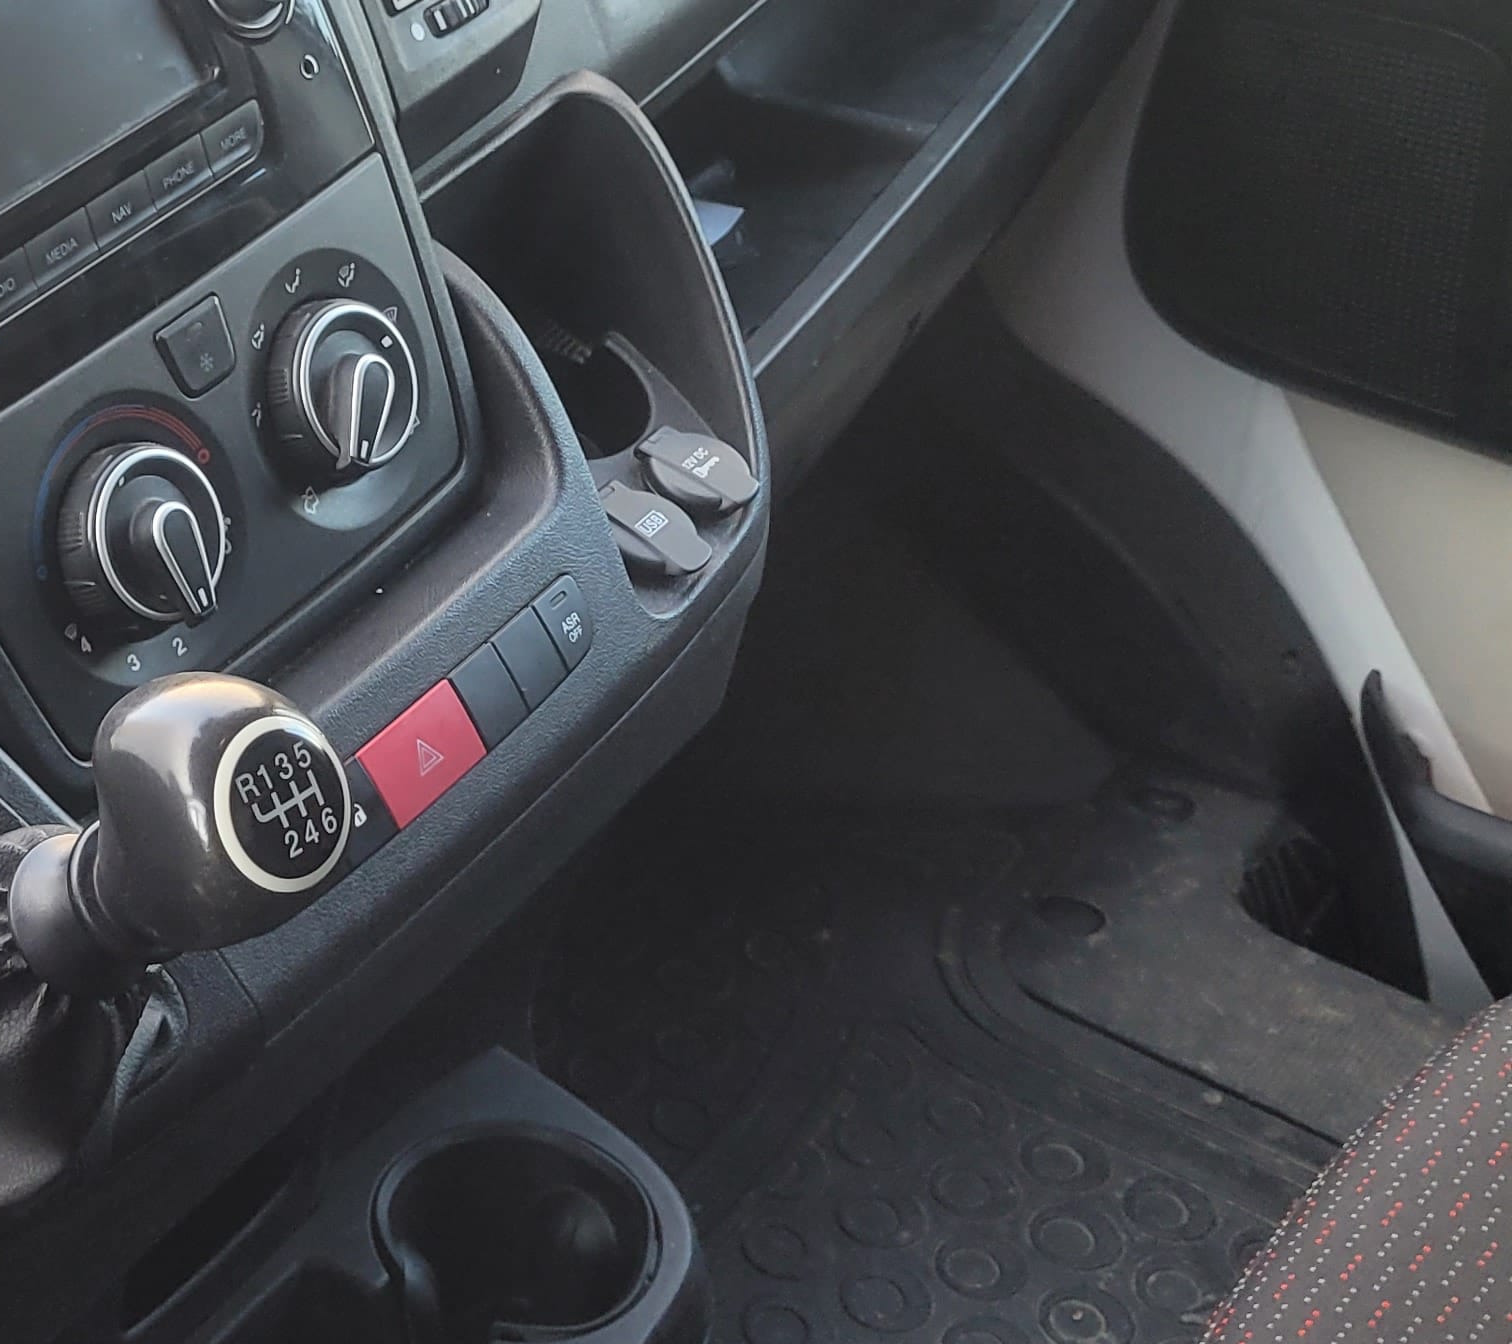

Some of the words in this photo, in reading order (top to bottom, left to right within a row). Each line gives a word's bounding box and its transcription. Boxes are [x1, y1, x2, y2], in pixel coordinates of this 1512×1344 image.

[220, 127, 247, 151] MORE
[162, 161, 195, 190] PHONE
[111, 202, 132, 224] NAV
[45, 237, 79, 265] MEDIA
[639, 513, 664, 535] USB
[562, 612, 581, 634] ASR
[569, 624, 584, 643] OFF
[172, 637, 188, 656] 2
[127, 653, 141, 671] 3
